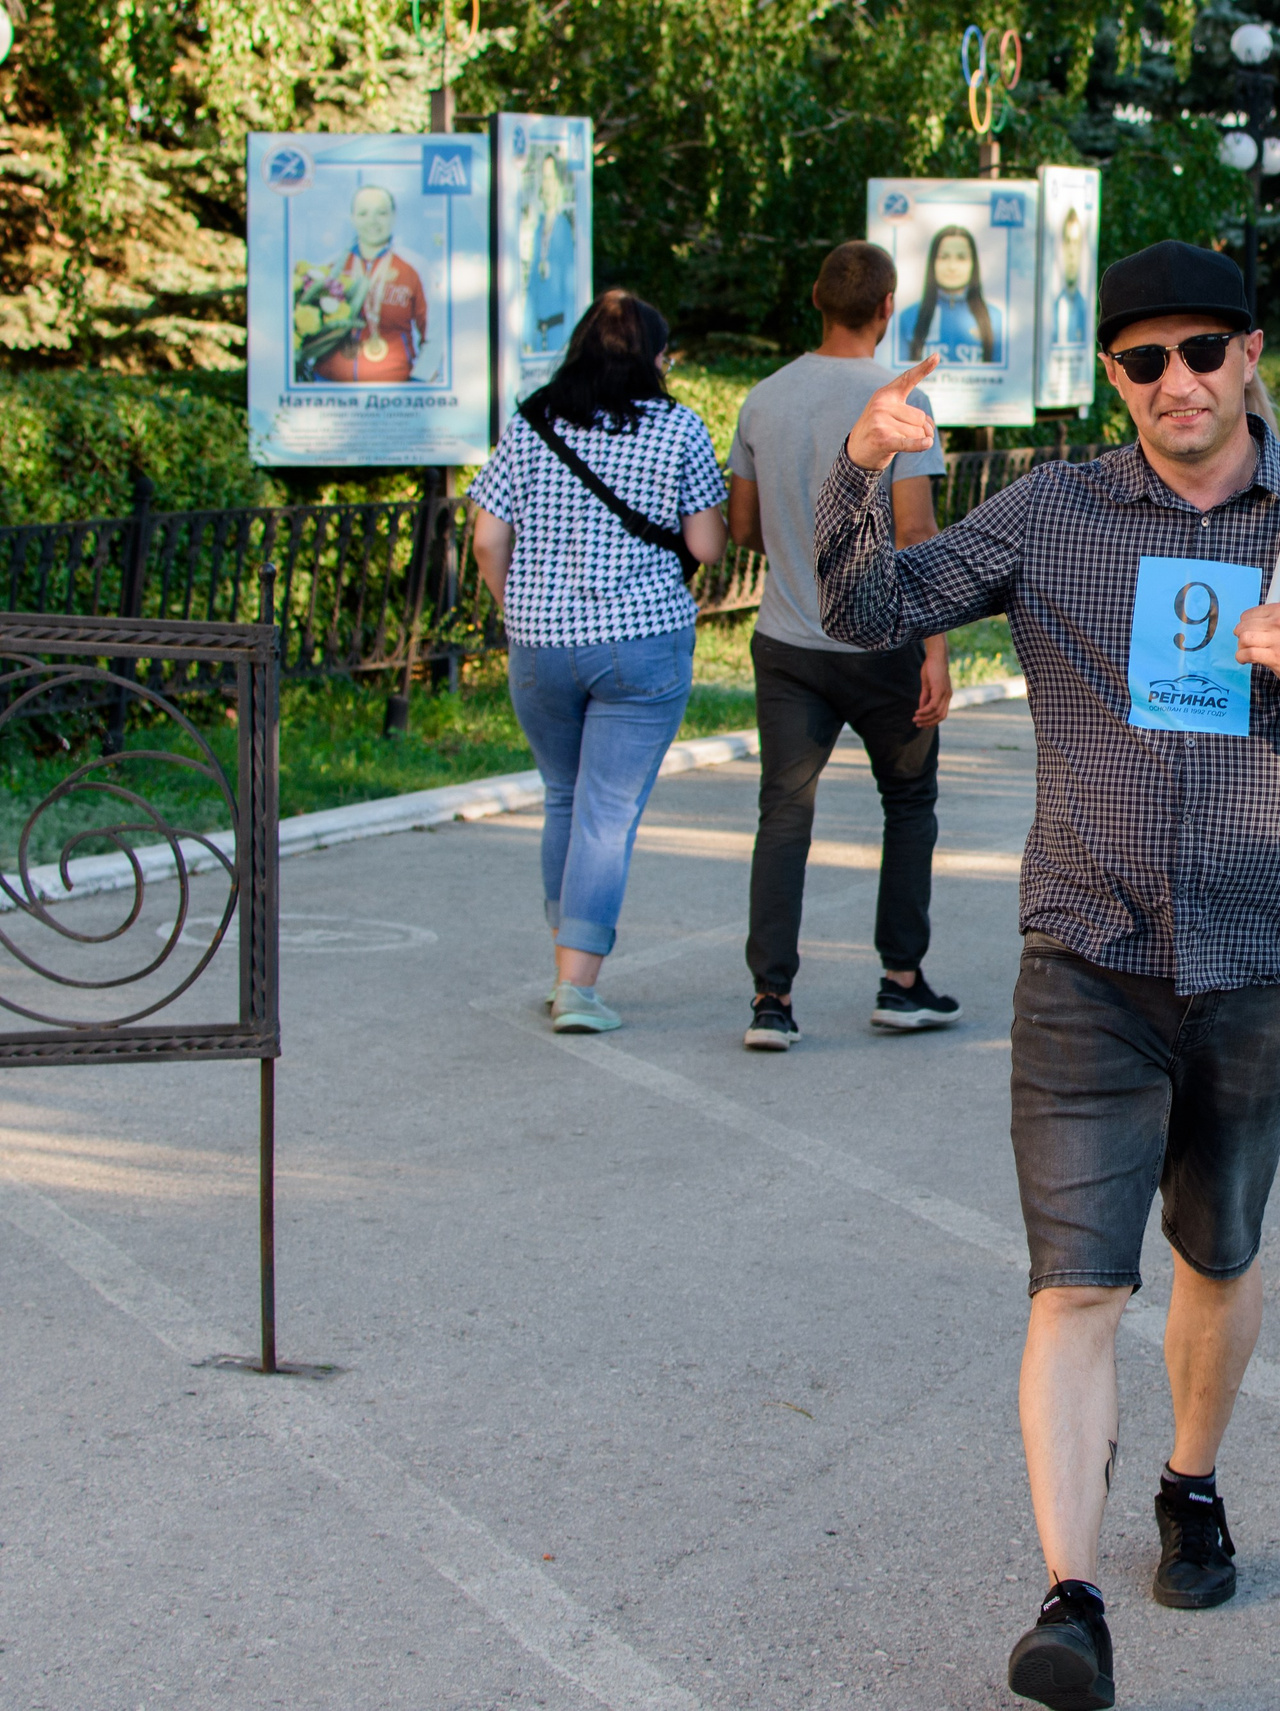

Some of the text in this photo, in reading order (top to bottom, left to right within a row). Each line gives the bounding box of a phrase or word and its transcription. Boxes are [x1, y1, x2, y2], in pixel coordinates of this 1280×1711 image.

[278, 395, 459, 409] Наталья Дроздова
[1173, 581, 1219, 652] 9
[1148, 690, 1229, 709] РЕГИНАС
